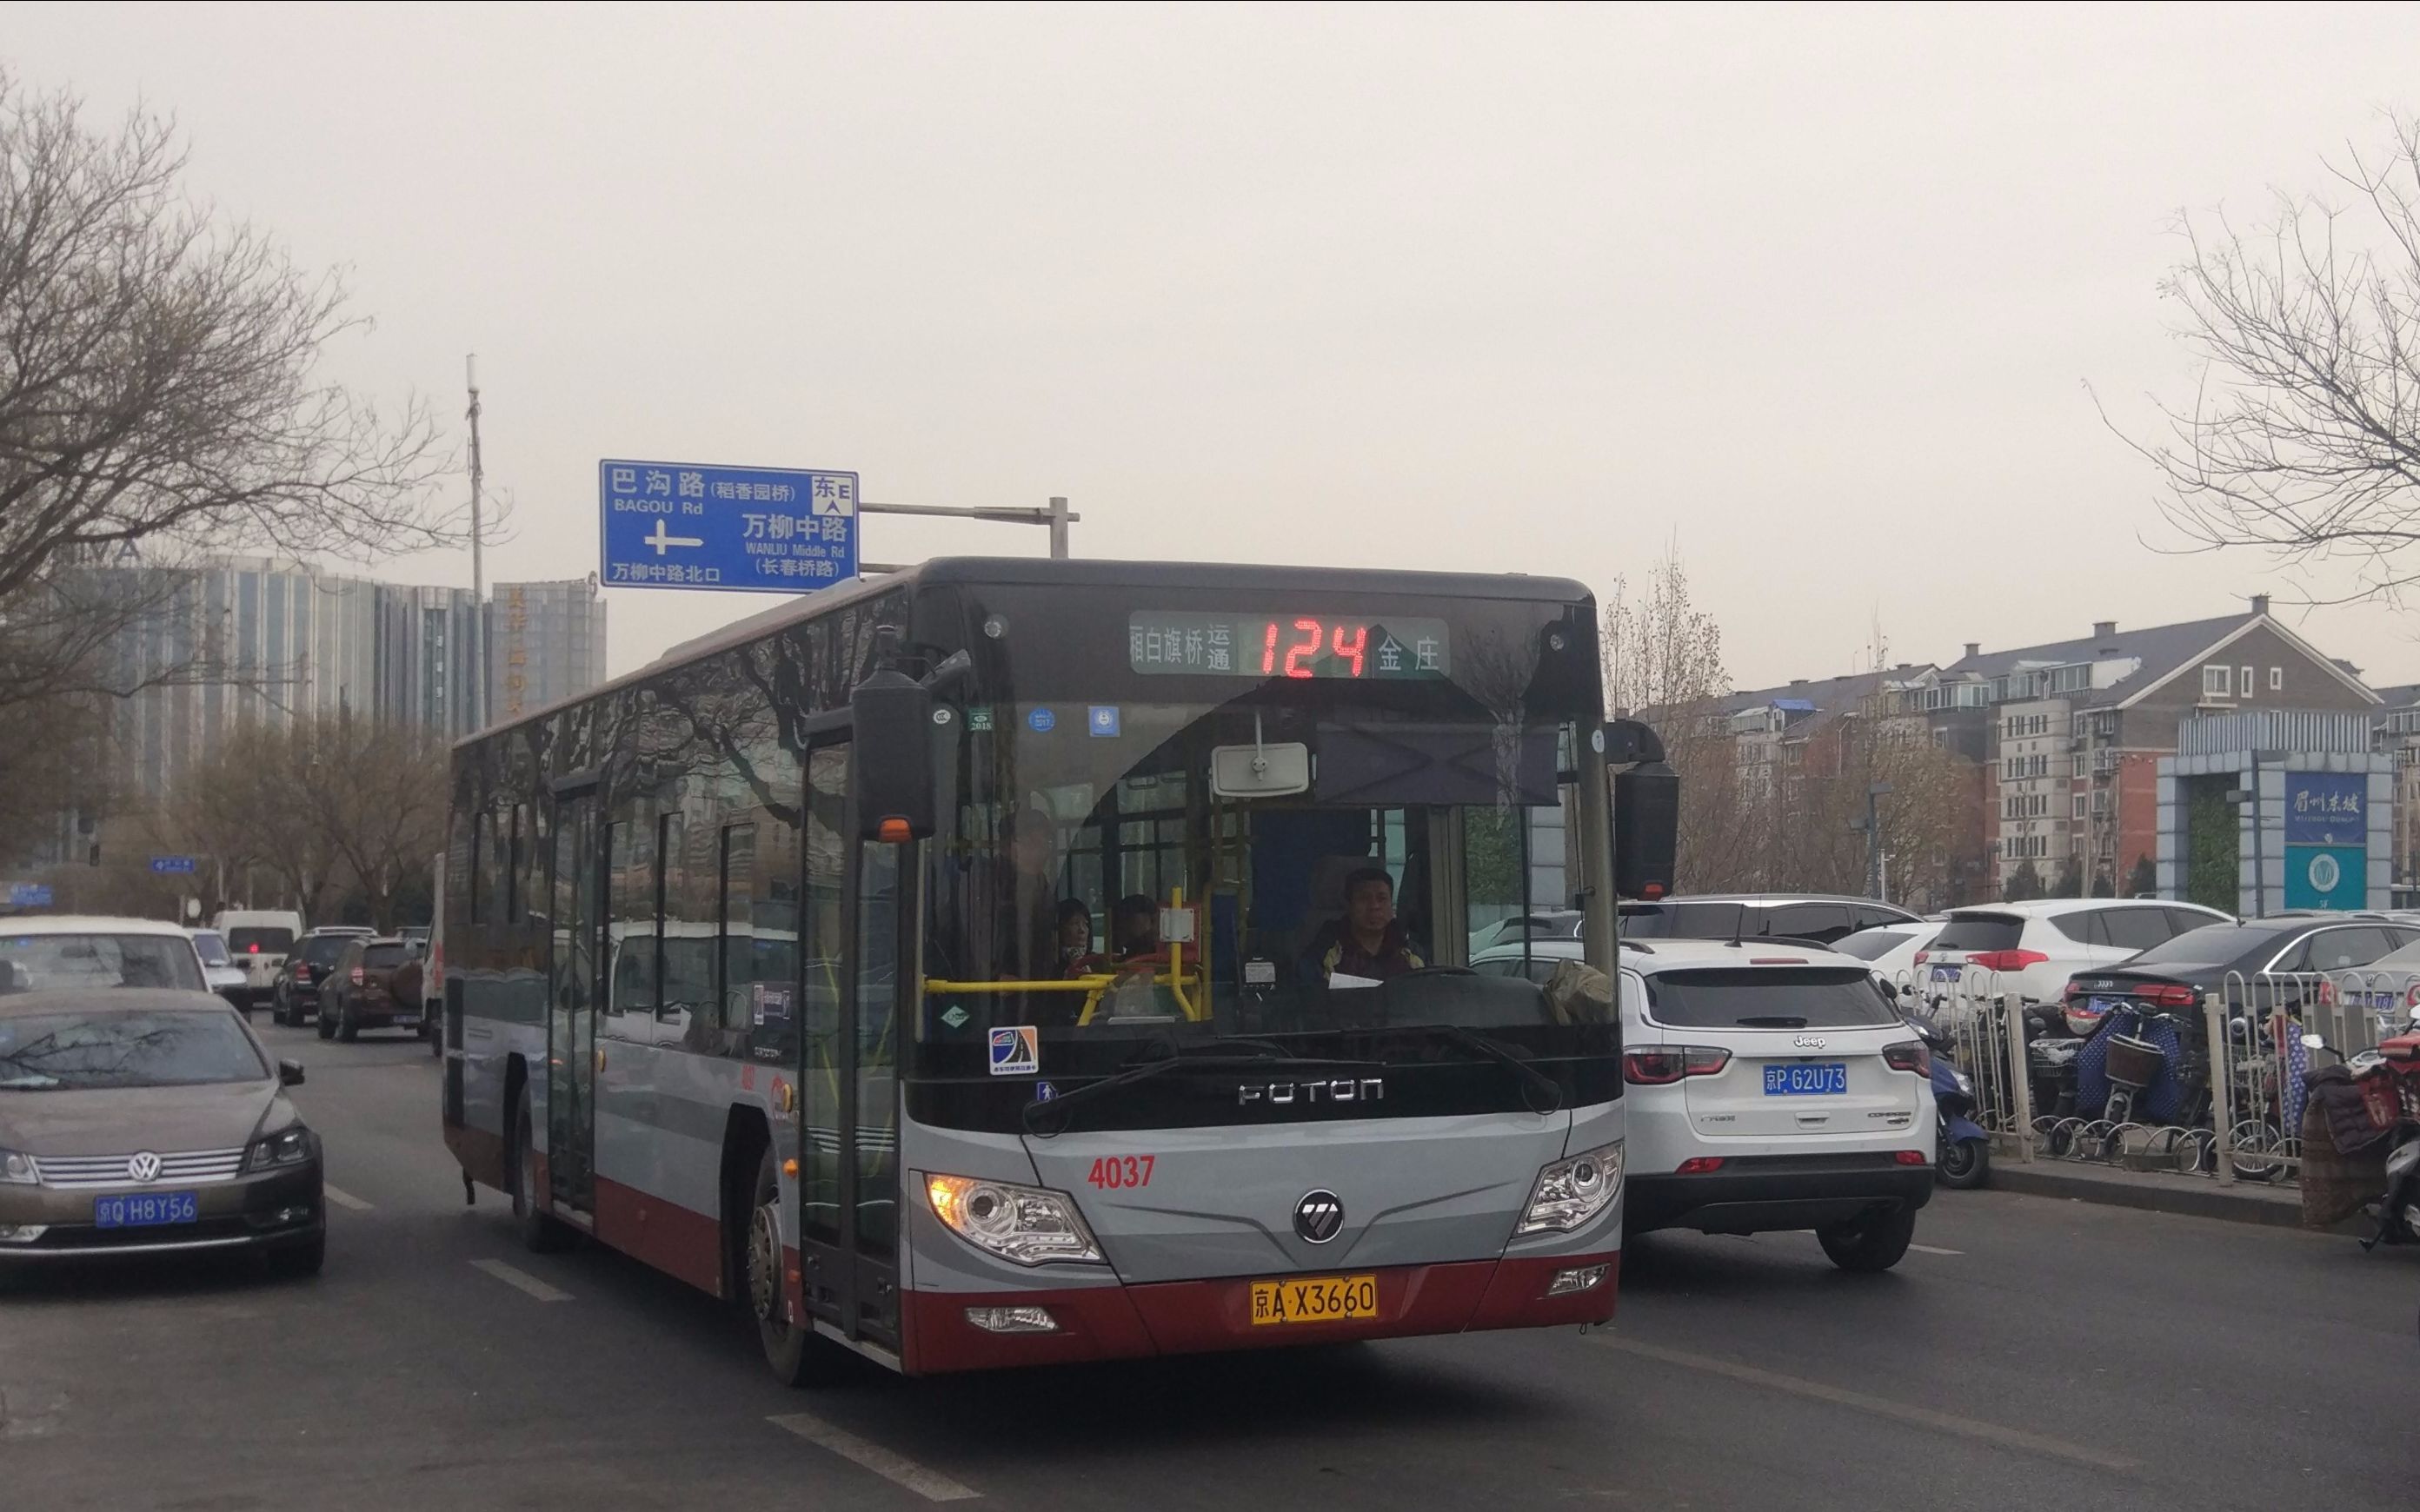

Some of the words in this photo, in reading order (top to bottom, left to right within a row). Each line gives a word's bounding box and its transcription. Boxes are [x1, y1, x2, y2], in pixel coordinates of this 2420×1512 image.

[612, 468, 705, 498] 巴沟路
[614, 500, 673, 514] BAGOU
[682, 502, 703, 515] Rd
[742, 514, 848, 542] 万柳中路
[746, 541, 788, 555] WANLIU
[793, 543, 826, 558] Middle
[831, 545, 845, 559] Rd
[612, 562, 721, 582] 万柳中路北口
[1261, 619, 1369, 679] 124
[1379, 633, 1439, 672] 金庄
[1794, 1036, 1825, 1049] Jeep
[1239, 1078, 1385, 1105] FOTON
[1087, 1155, 1155, 1190] 4037
